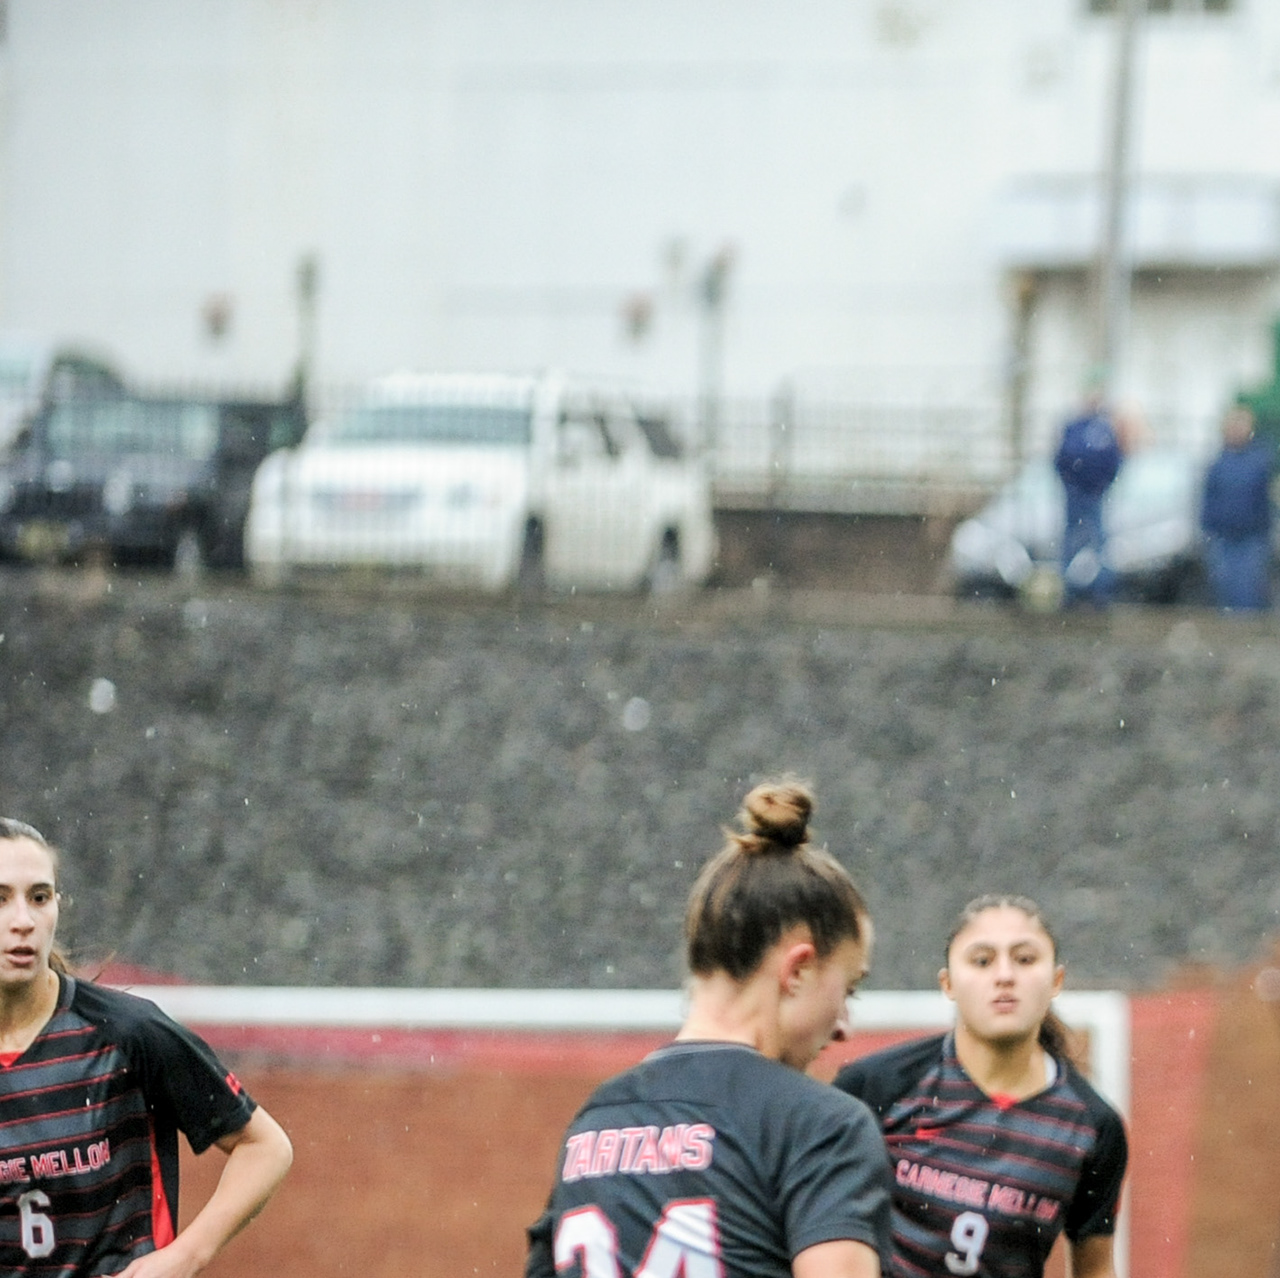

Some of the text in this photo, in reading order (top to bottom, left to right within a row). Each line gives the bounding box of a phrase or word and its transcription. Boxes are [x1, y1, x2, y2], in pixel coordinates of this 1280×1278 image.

[30, 1137, 111, 1180] MELLON
[562, 1123, 716, 1183] TARTANS
[17, 1188, 56, 1259] 6
[944, 1210, 990, 1277] 9
